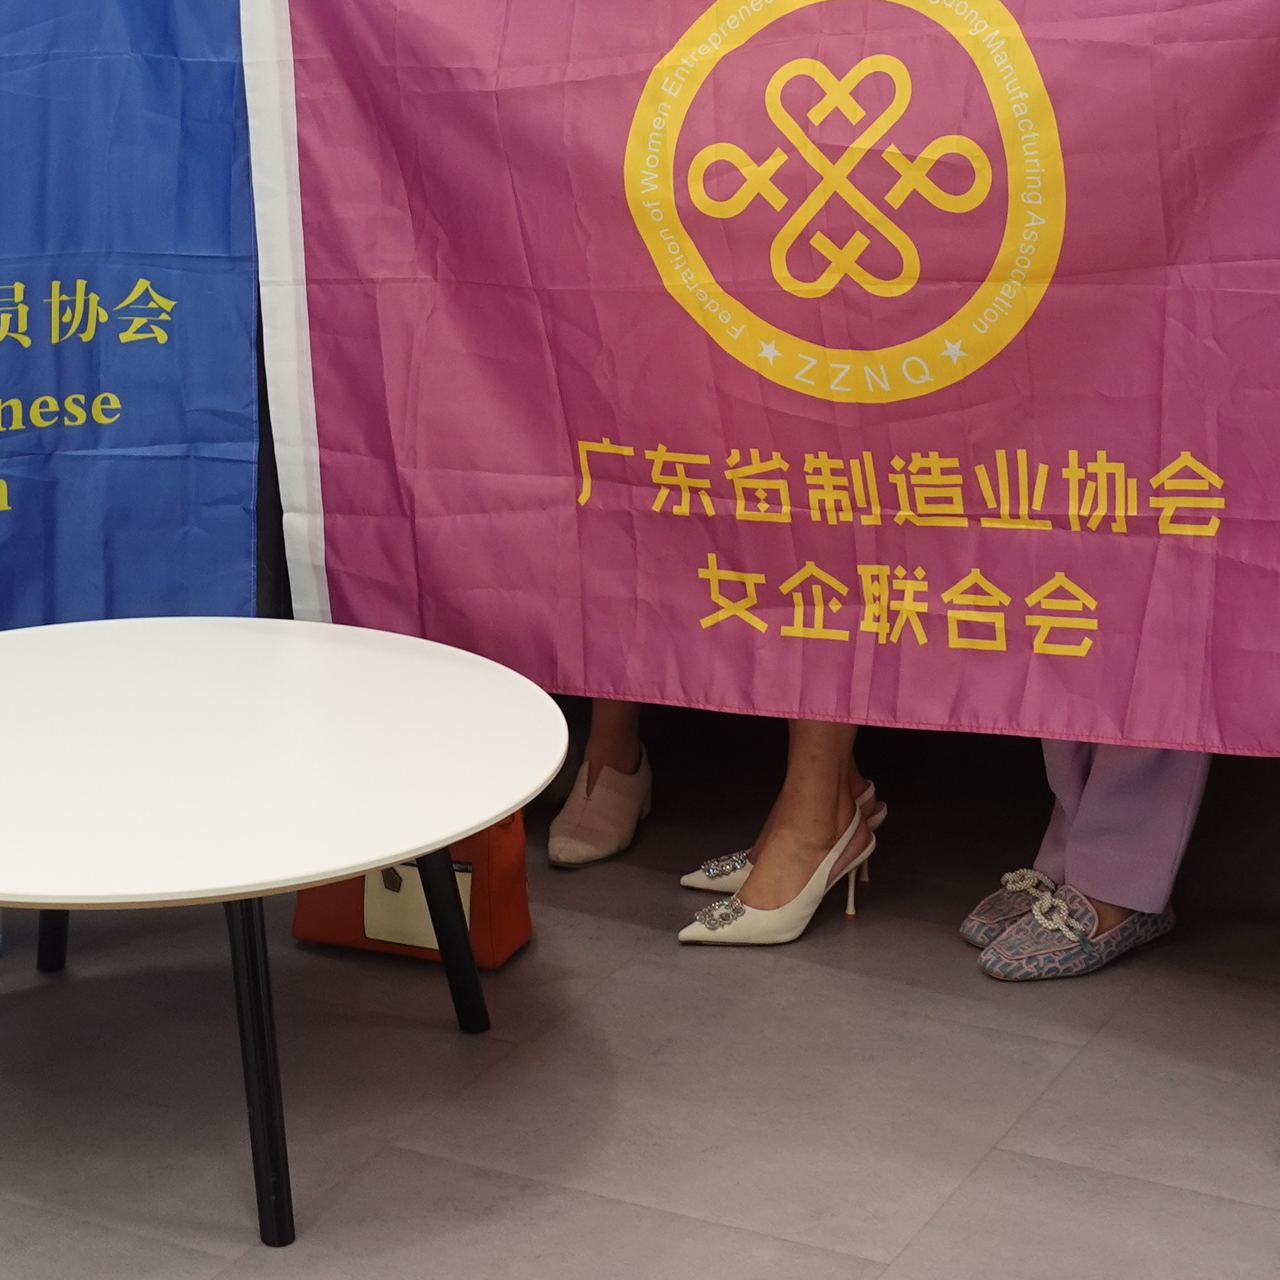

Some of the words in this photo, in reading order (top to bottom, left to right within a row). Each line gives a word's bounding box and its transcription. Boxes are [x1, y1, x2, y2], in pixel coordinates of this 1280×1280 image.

[640, 102, 671, 193] Women
[982, 29, 1047, 205] Manufacturing
[641, 200, 664, 223] of
[659, 228, 746, 340] Federation
[972, 210, 1047, 335] Association
[794, 355, 934, 393] ZZNQ
[577, 437, 1226, 537] 广东省制造业协会
[697, 553, 1099, 657] 女企联合会
